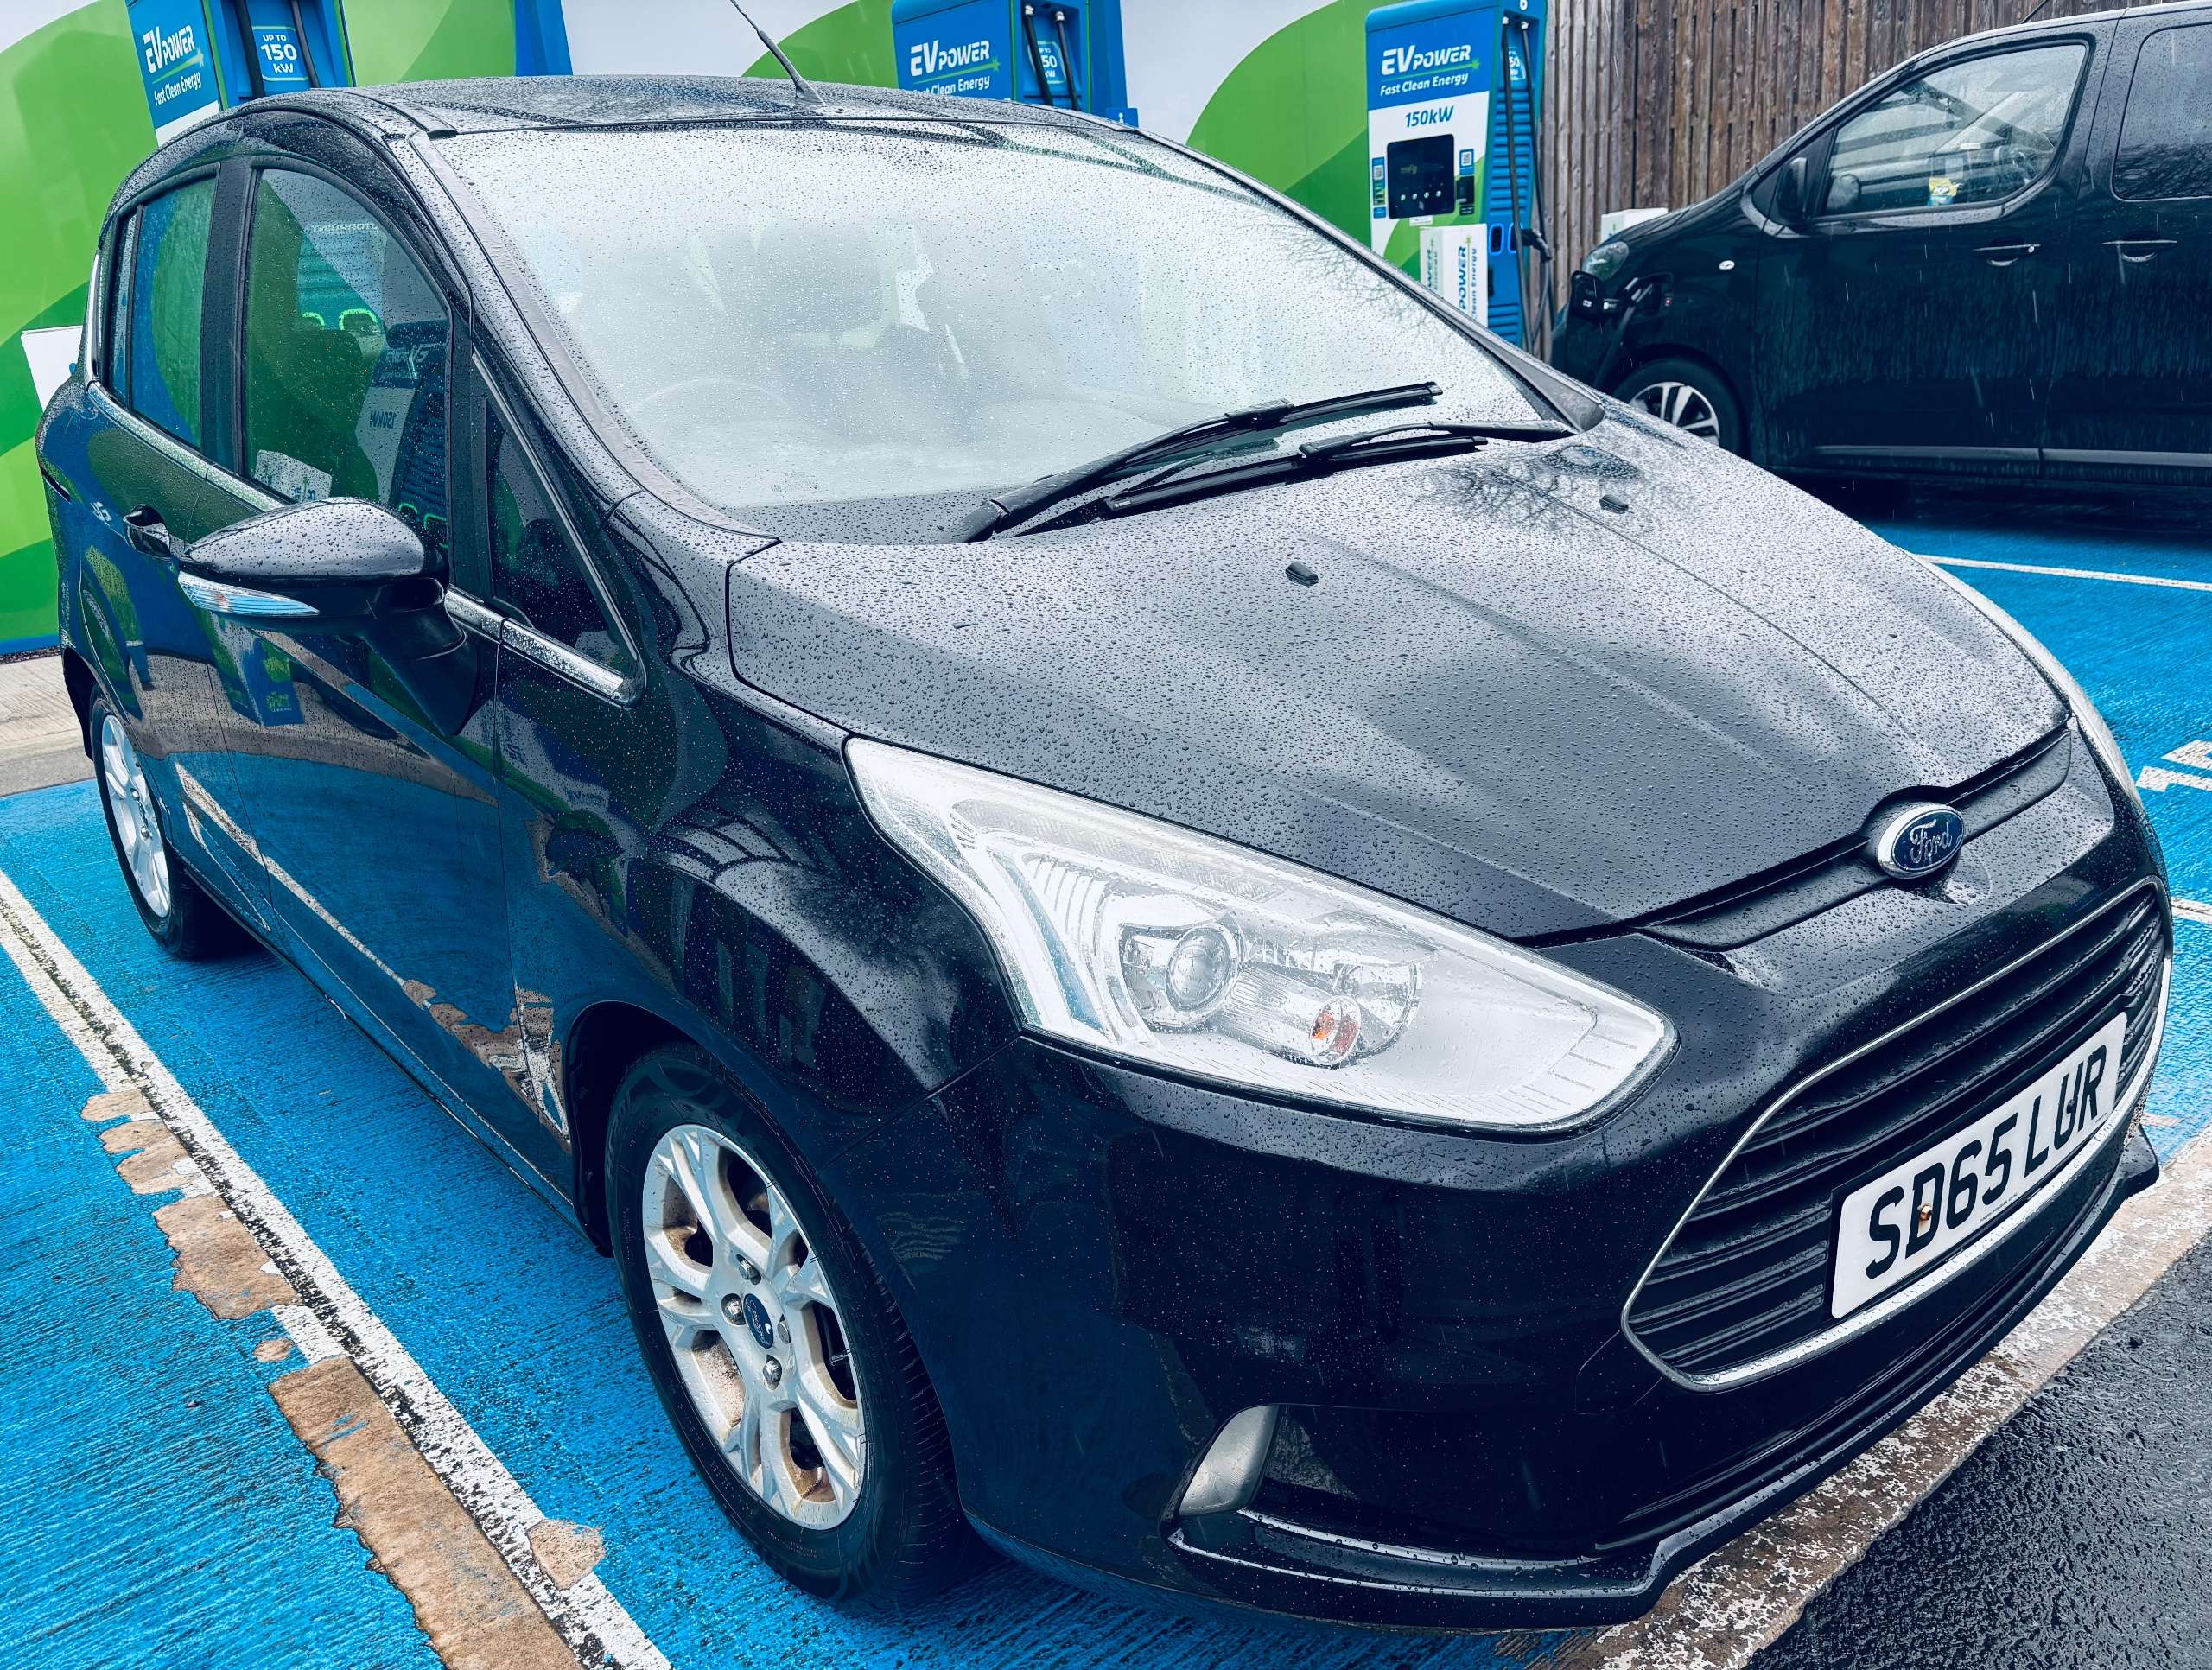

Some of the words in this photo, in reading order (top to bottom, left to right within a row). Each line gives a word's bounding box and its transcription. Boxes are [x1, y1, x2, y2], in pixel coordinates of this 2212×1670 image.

[261, 44, 297, 60] 150
[1040, 55, 1058, 68] 50
[273, 63, 293, 73] kW
[154, 87, 167, 106] Fast
[165, 82, 181, 101] Clean
[180, 71, 202, 92] Energy
[931, 84, 956, 95] Clean
[957, 76, 990, 92] Energy
[1380, 84, 1401, 97] Fast
[1402, 79, 1431, 92] Clean
[1432, 73, 1469, 87] Energy
[1405, 105, 1455, 128] 150kW
[1910, 819, 1953, 864] Ford
[1865, 1112, 2018, 1279] SD65
[2024, 1045, 2107, 1178] LUR
